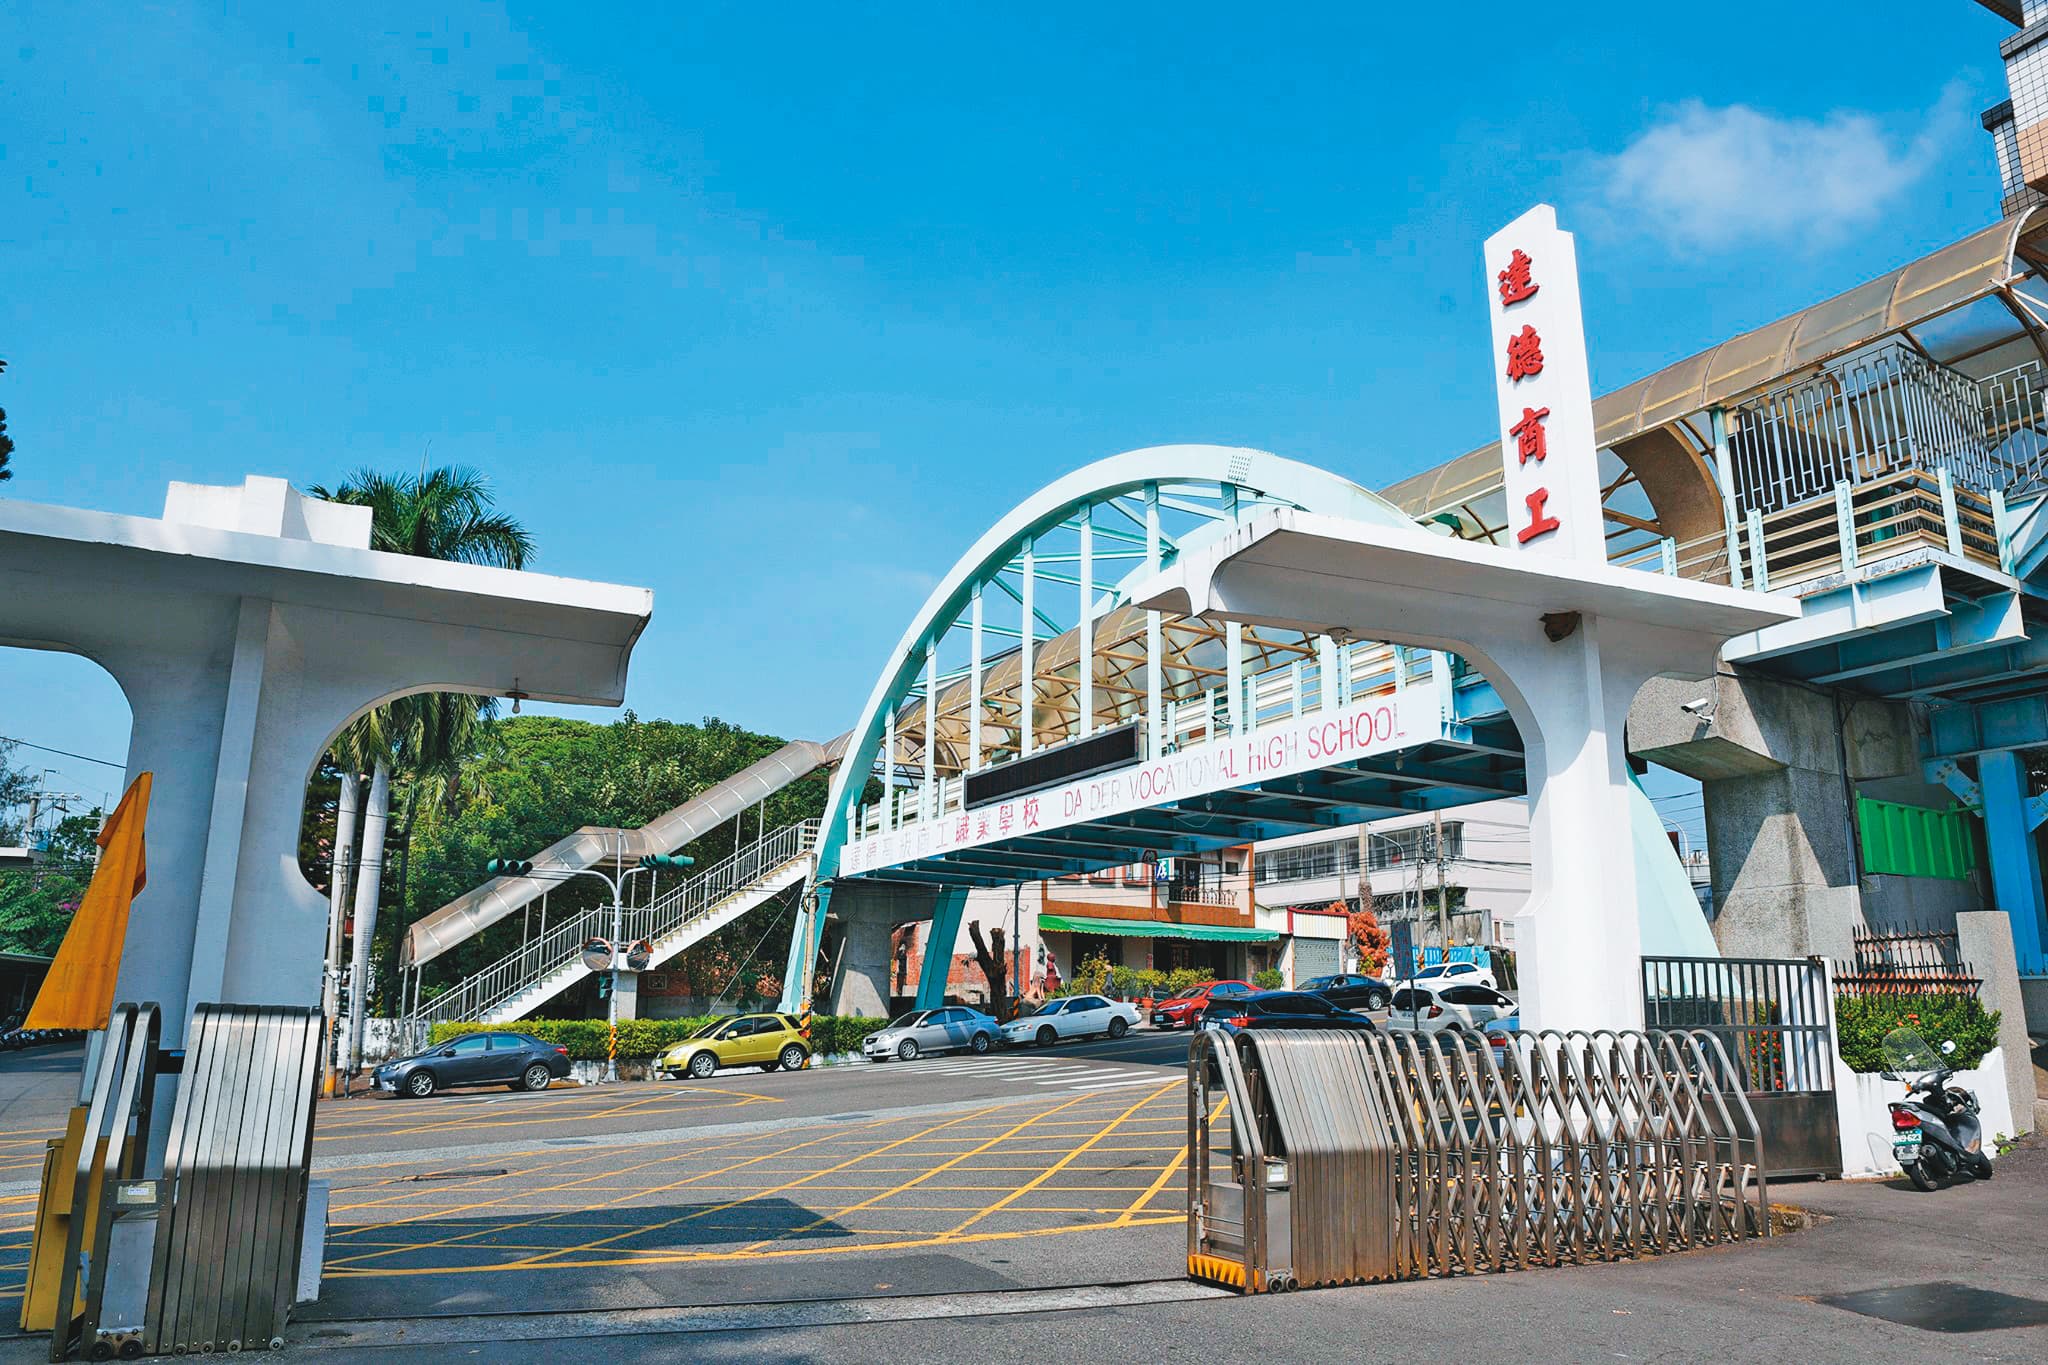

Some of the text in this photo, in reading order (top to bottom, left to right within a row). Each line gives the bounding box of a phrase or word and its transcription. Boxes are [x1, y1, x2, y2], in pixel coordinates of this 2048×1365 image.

[1497, 248, 1560, 544] 達德商工
[1064, 703, 1407, 817] DA DER VOCATIONAL HIGH SCHOOL
